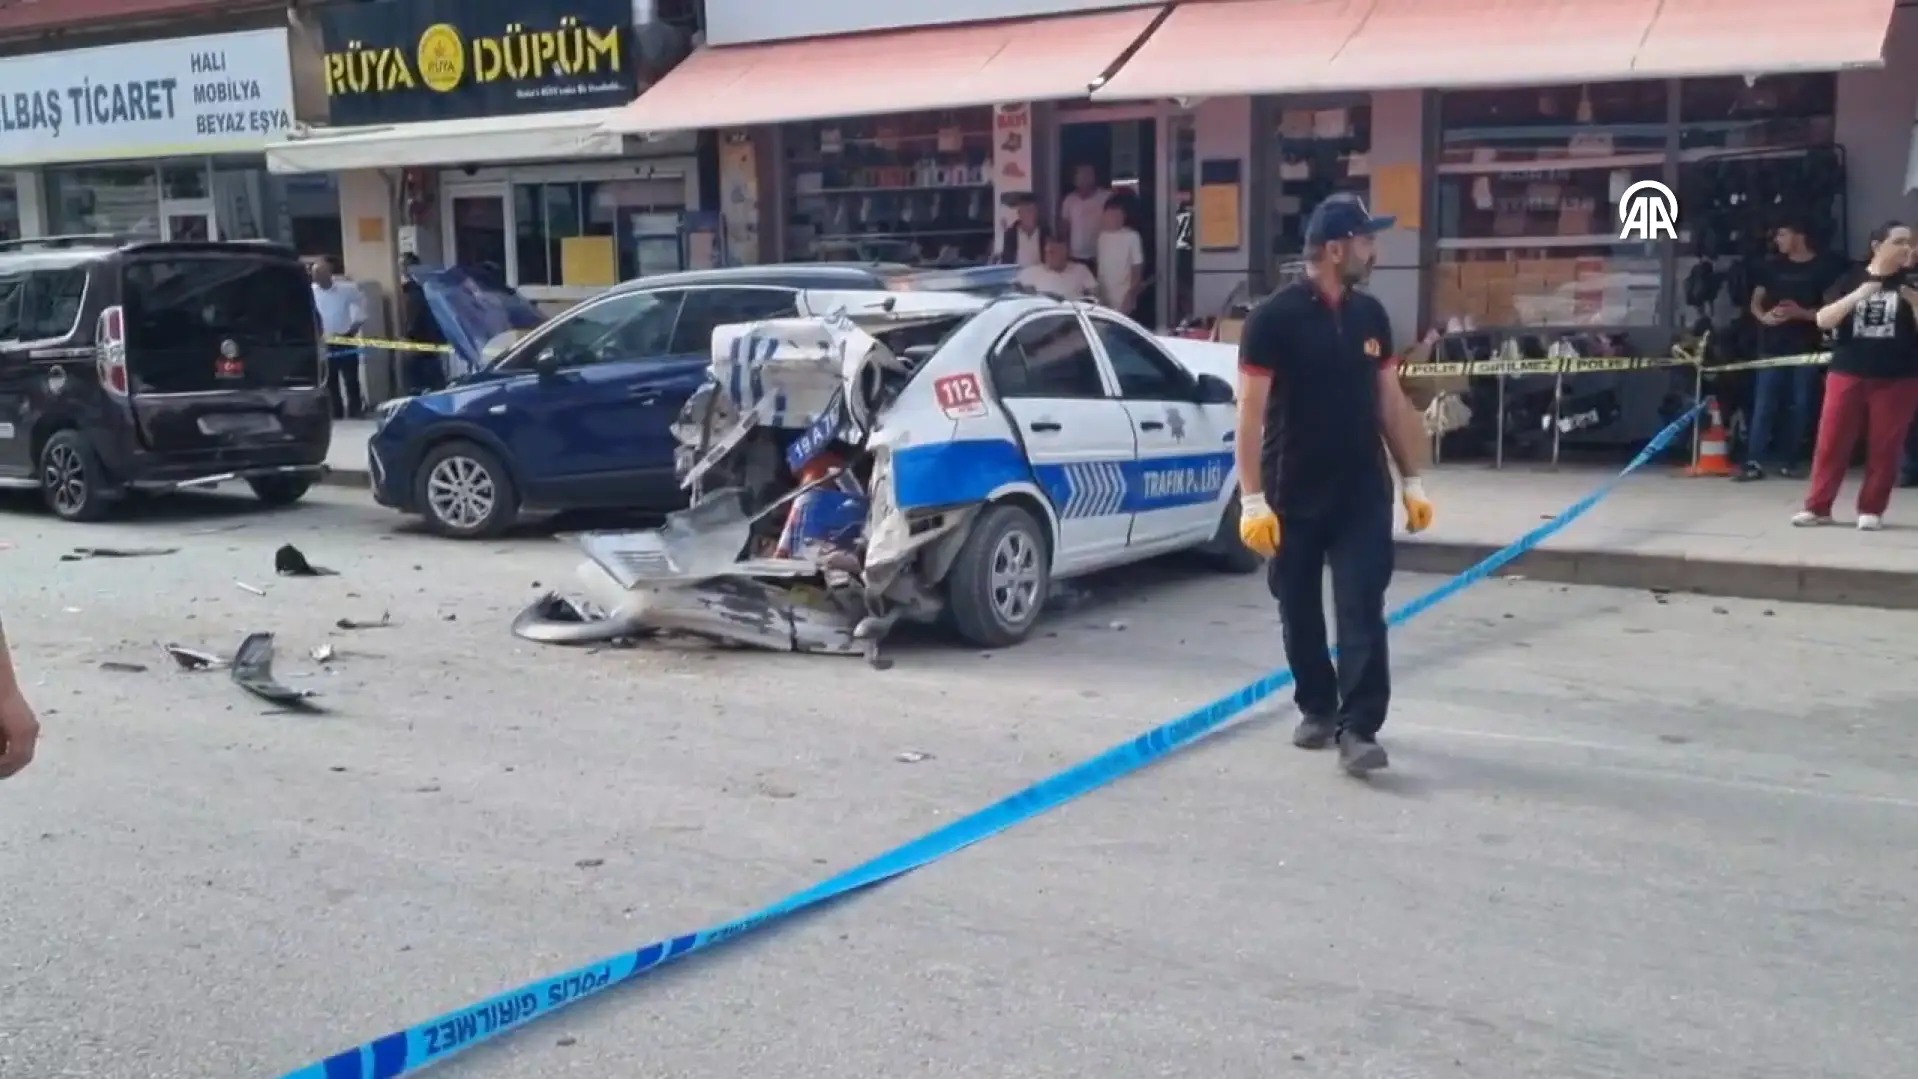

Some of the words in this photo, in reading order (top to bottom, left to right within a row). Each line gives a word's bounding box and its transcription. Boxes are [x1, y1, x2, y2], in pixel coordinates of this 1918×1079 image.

[191, 51, 226, 73] HALI
[324, 40, 414, 95] RÜYA
[193, 77, 261, 104] MOBİLYA
[0, 88, 62, 138] LBAŞ
[67, 76, 177, 126] TİCARET
[196, 112, 246, 134] BEYAZ
[250, 108, 291, 136] EŞYA
[941, 378, 977, 405] 112
